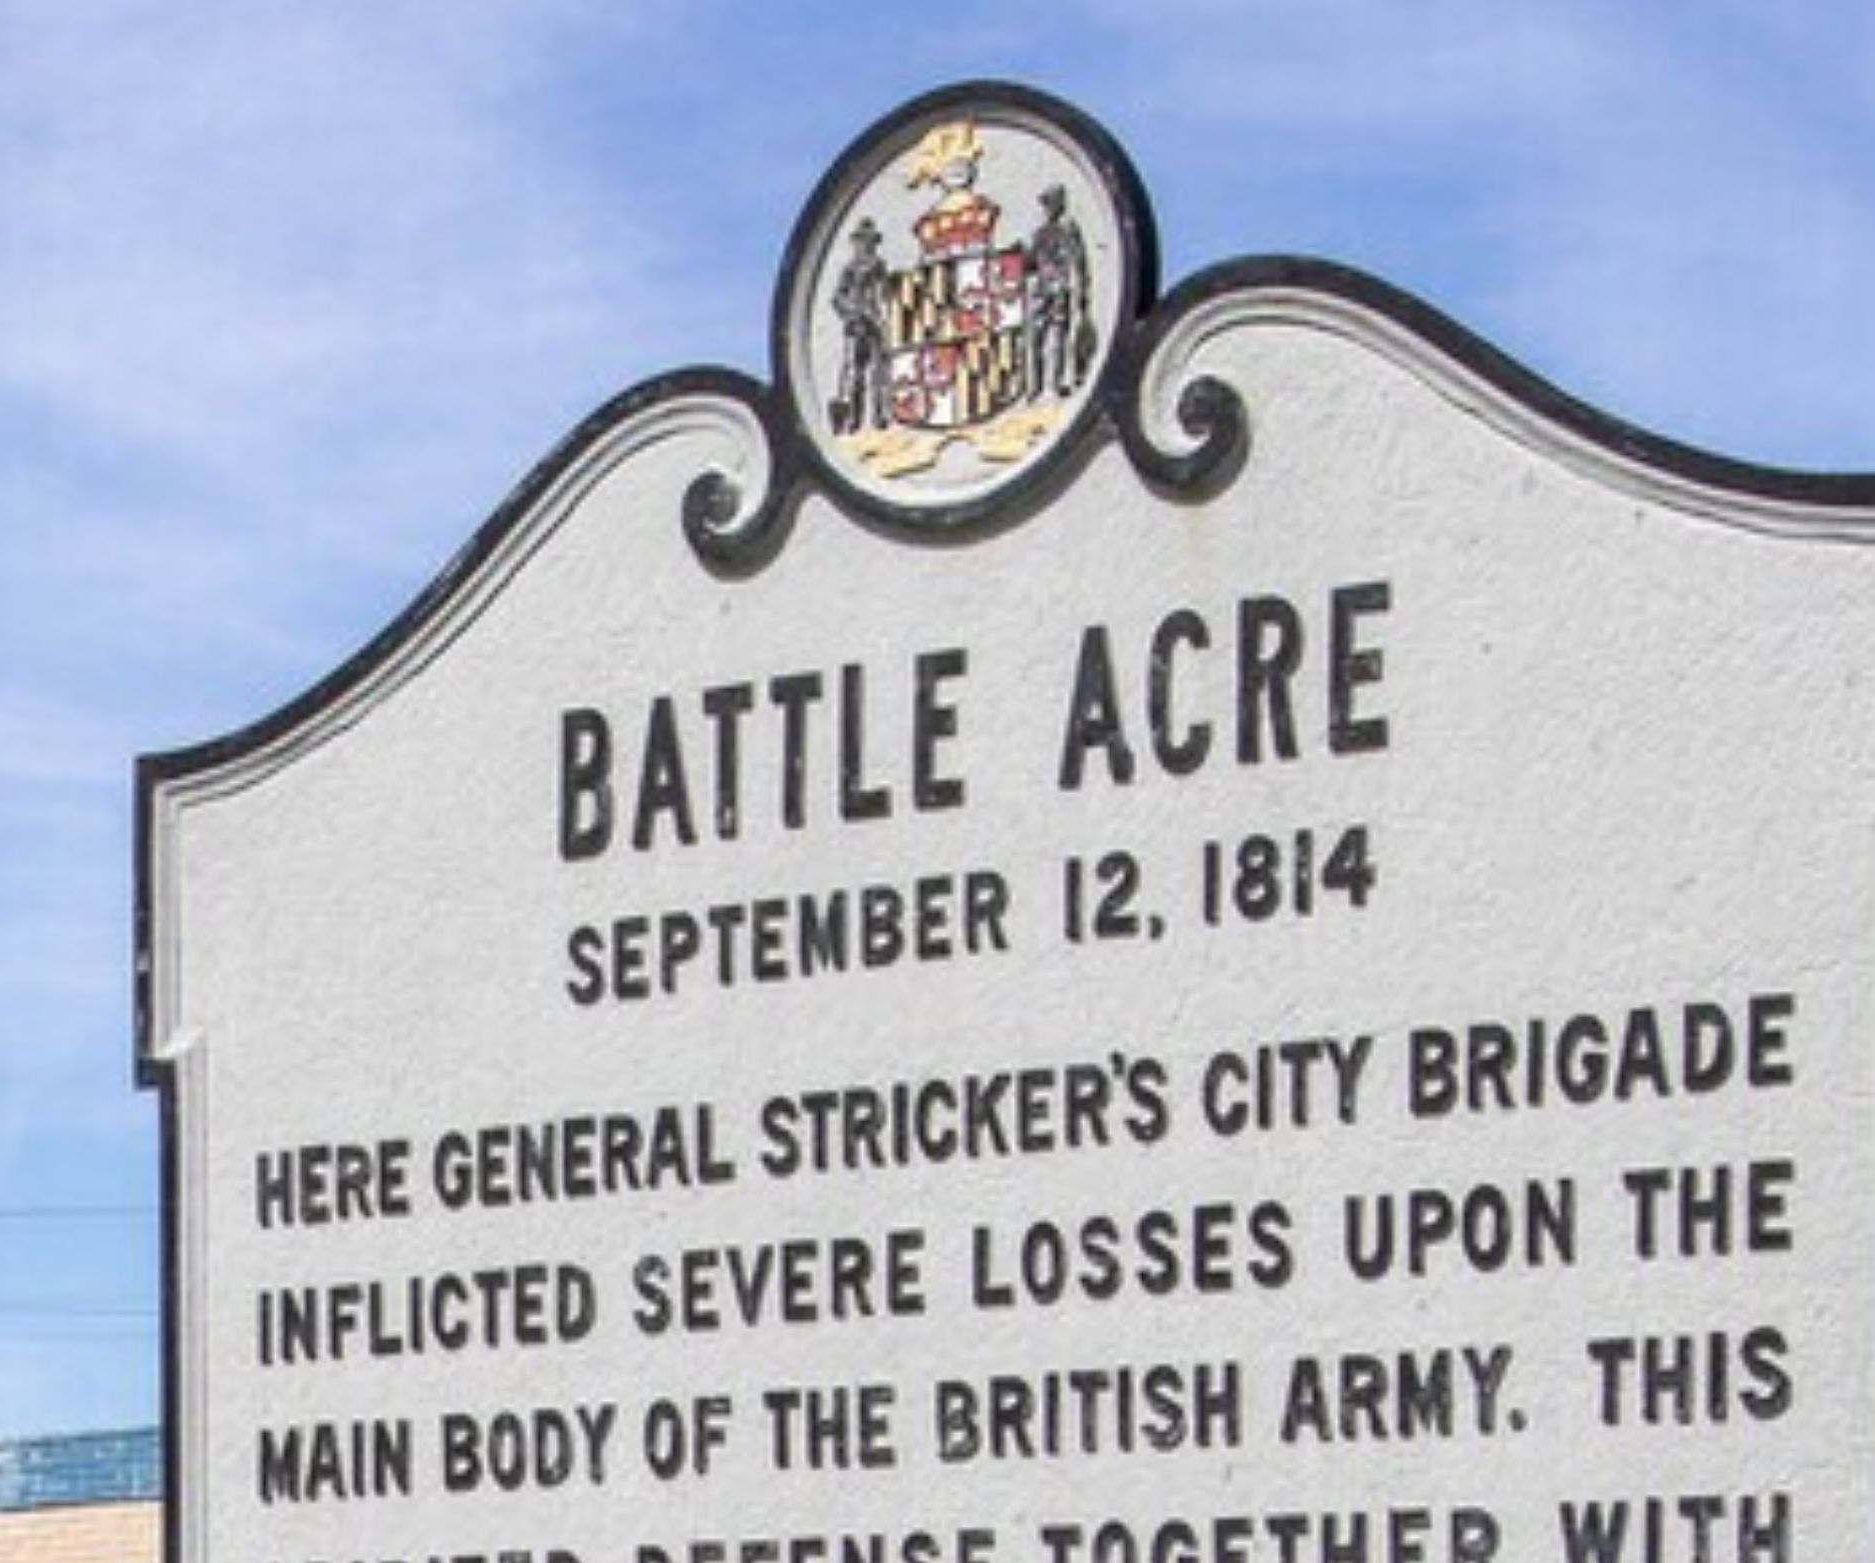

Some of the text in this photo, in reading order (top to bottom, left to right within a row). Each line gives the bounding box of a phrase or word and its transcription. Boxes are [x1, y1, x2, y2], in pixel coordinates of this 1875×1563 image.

[558, 581, 1391, 863] BATTLE ACRE
[566, 825, 1376, 1006] SEPTEMBER 12, 1814
[256, 993, 1795, 1230] HERE GENERAL STRICKER'S CITY BRIGADE
[259, 1159, 1794, 1367] INFLICTED SEVERE LOSSES UPON THE
[258, 1325, 1793, 1505] MAIN BODY OF THE BRITISH ARMY. THIS
